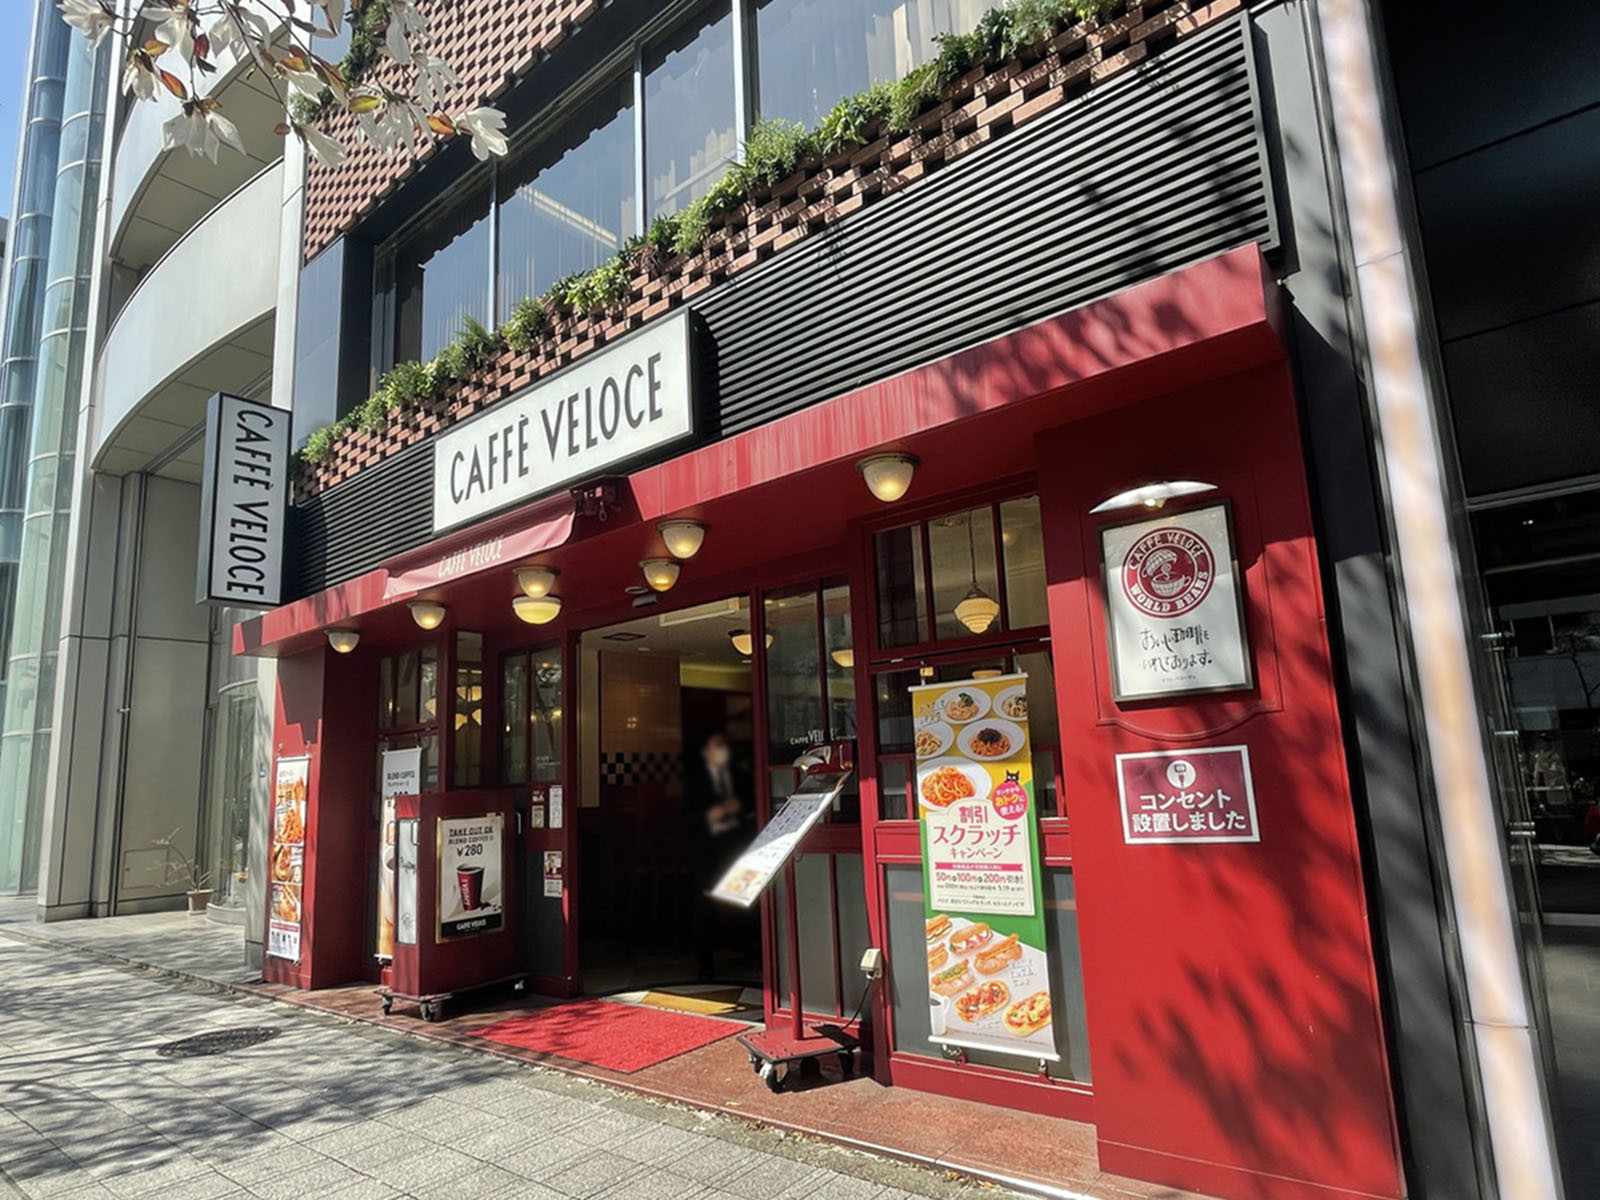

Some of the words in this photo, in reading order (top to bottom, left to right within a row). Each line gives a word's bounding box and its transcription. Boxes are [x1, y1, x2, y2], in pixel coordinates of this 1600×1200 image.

[451, 414, 529, 505] CAFFÈ
[541, 352, 663, 462] VELOCE
[233, 410, 274, 491] CAFFÈ
[226, 501, 270, 596] VELOCE
[469, 535, 505, 567] VELOCE
[1166, 531, 1206, 558] VELOCE
[1129, 583, 1171, 613] WORLD
[1175, 570, 1210, 610] BEANS
[1138, 788, 1231, 811] コンセント
[958, 804, 989, 824] 割引
[1131, 810, 1247, 833] 設置しました
[449, 828, 468, 837] TAKE
[468, 826, 483, 835] OUT
[483, 825, 494, 834] OK
[932, 823, 1022, 847] スクラッチ
[949, 846, 1004, 859] キャンペーン
